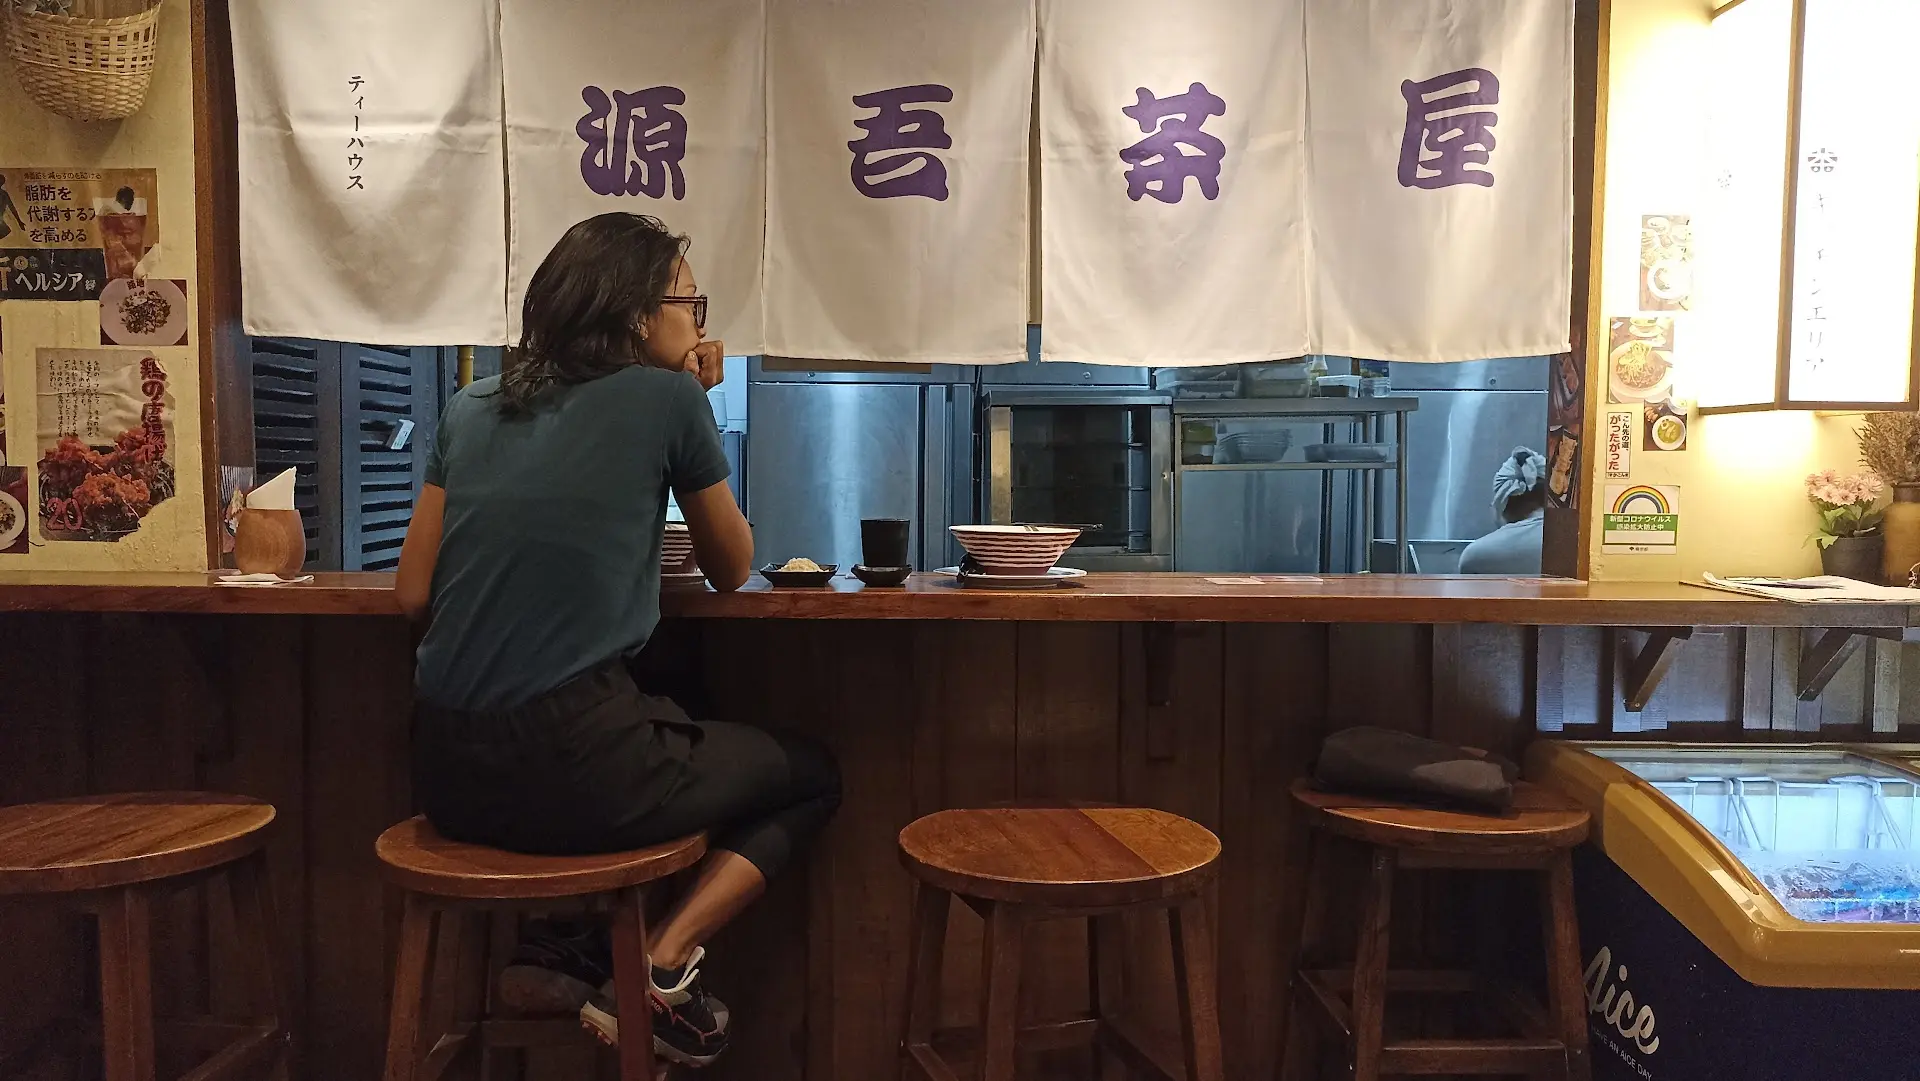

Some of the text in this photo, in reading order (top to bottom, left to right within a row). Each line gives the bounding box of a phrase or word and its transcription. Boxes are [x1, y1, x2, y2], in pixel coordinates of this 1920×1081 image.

[346, 75, 365, 190] ティーハウス
[25, 184, 72, 201] 脂肪を
[29, 226, 87, 243] を高める
[1608, 414, 1621, 471] がったがった
[1610, 515, 1671, 523] 新型コロナウイルス
[1616, 523, 1664, 531] 感染拡大防止中
[1583, 946, 1659, 1054] Aice
[1609, 1040, 1619, 1054] AN
[1620, 1050, 1636, 1069] AICE
[1637, 1063, 1652, 1081] DAY
